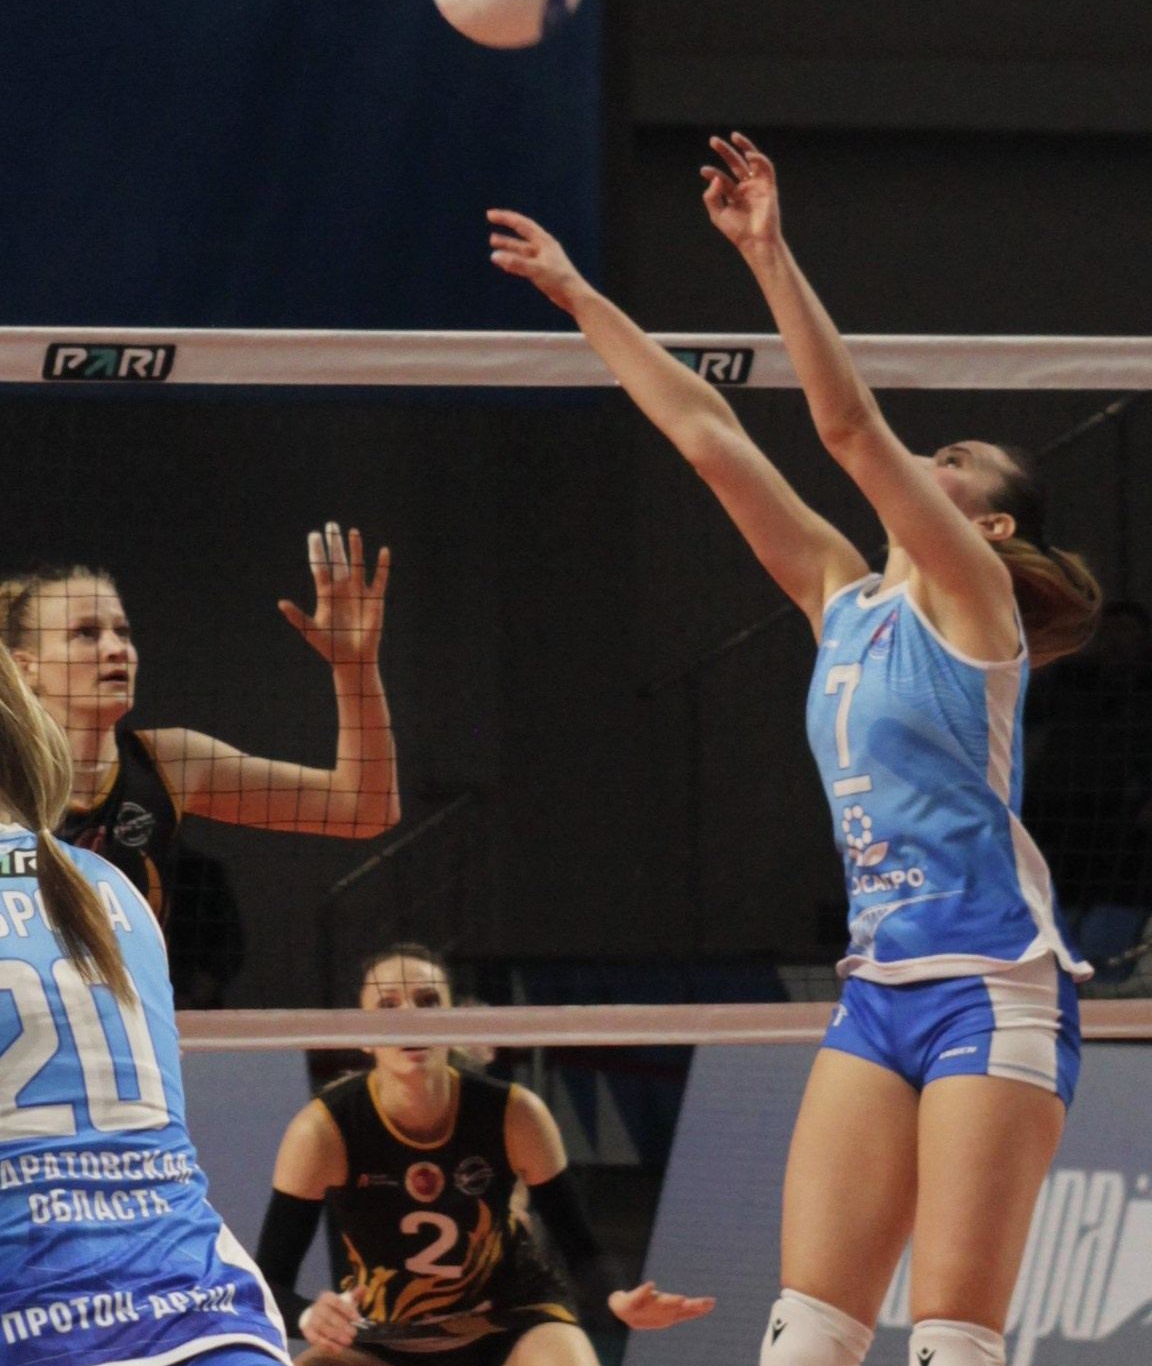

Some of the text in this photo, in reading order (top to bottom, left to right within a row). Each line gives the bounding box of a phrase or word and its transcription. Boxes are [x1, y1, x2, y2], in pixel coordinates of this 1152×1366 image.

[53, 348, 166, 377] PARI
[824, 663, 862, 769] 7
[28, 1188, 172, 1224] ОБЛАСТЬ
[401, 1212, 462, 1277] 2
